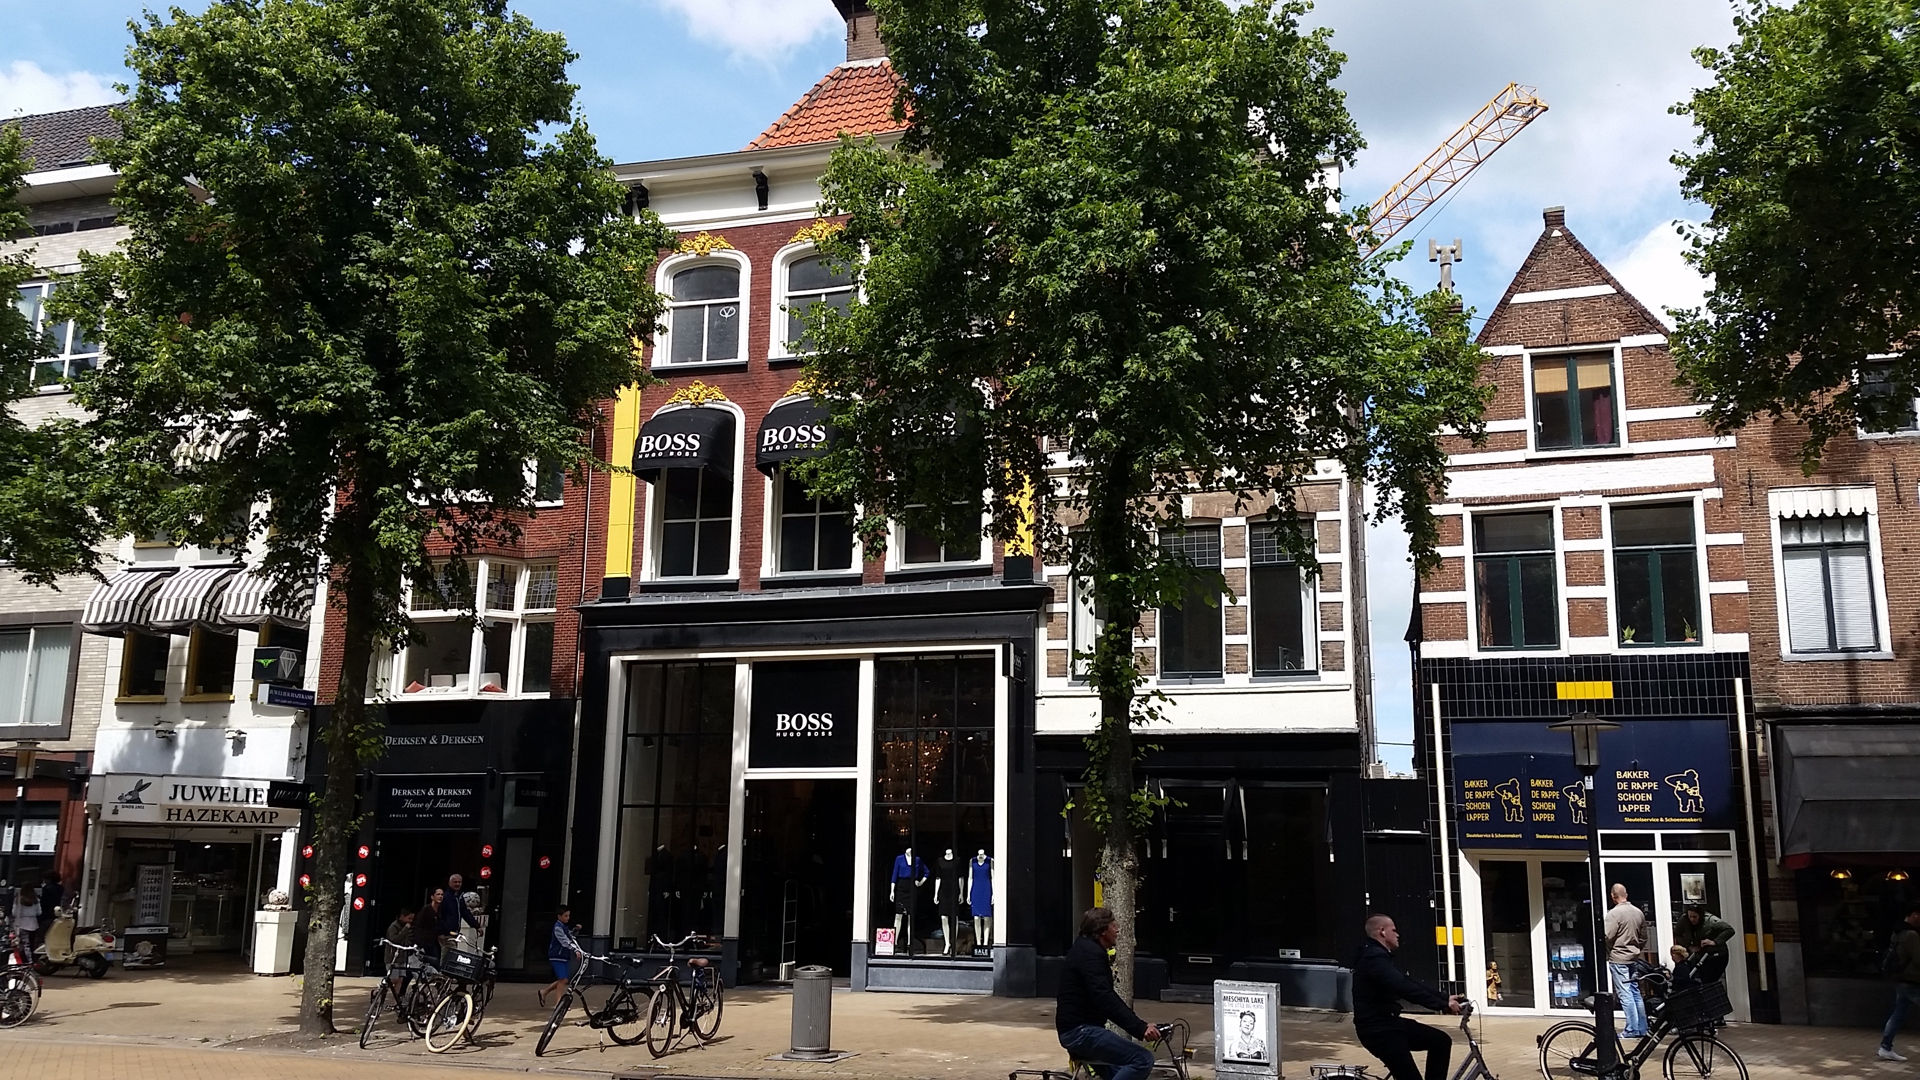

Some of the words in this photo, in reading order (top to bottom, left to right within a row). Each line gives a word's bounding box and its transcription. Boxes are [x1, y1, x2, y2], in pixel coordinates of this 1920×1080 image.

[762, 424, 826, 447] BOSS
[639, 433, 700, 453] BOSS
[761, 444, 788, 453] HUGO
[638, 451, 663, 459] HUGO
[776, 712, 834, 731] BOSS
[384, 735, 427, 746] DERKSEN
[429, 735, 438, 745] &
[441, 734, 485, 745] DERKSEN
[1616, 770, 1650, 779] BAKKER
[1464, 780, 1488, 788] BAKKER
[1530, 779, 1554, 788] BAKKER
[1617, 782, 1629, 790] DE
[1631, 781, 1659, 790] RAPPE
[169, 784, 269, 805] JUWELIE
[392, 788, 426, 796] DERKSEN
[428, 788, 435, 796] &
[437, 787, 472, 796] DERKSEN
[1465, 791, 1473, 799] DE
[1475, 790, 1495, 799] RAPPE
[1531, 790, 1540, 799] DE
[1541, 790, 1560, 800] RAPPE
[1617, 793, 1653, 802] SCHOEN
[401, 799, 424, 808] House
[425, 799, 434, 811] of
[434, 799, 461, 808] Fashion
[1465, 802, 1491, 810] SCHOEN
[1531, 802, 1556, 810] SCHOEN
[1618, 804, 1651, 813] LAPPER
[166, 808, 279, 824] HAZEKAMP
[1466, 813, 1490, 821] LAPPER
[1532, 813, 1555, 821] LAPPER
[1223, 995, 1250, 1003] MESCHIYA
